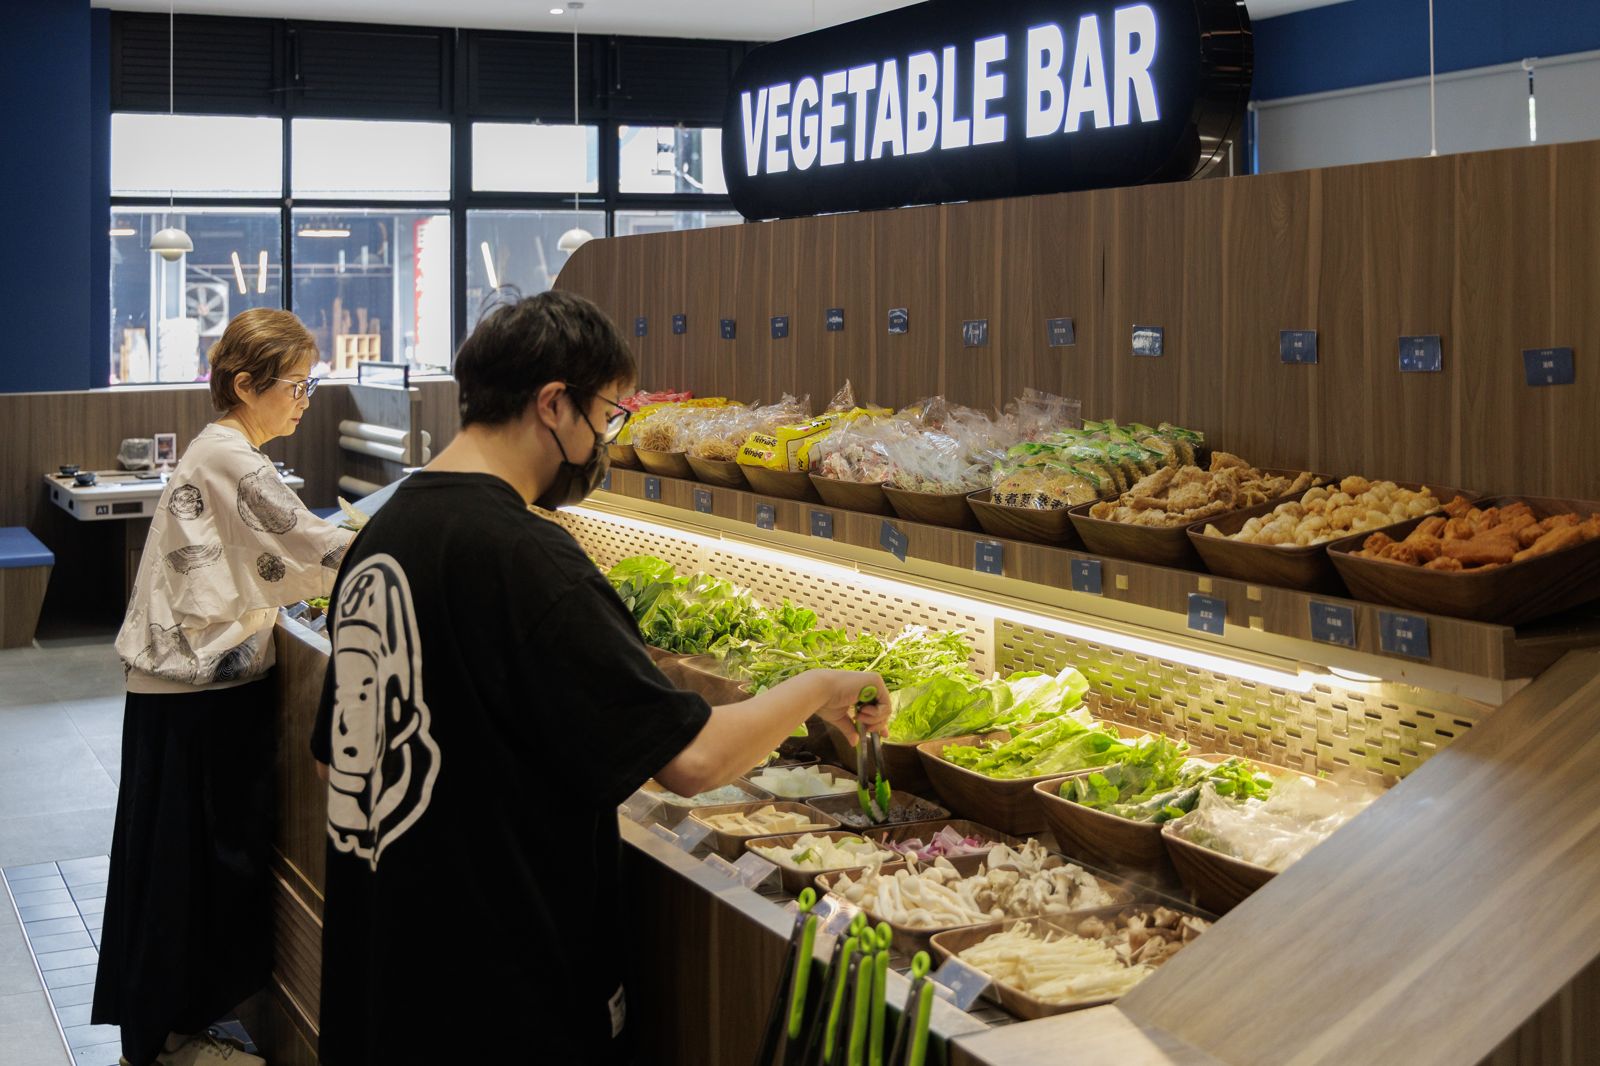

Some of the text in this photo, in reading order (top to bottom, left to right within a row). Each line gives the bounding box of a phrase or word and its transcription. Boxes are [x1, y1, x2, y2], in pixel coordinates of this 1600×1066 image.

[740, 3, 1161, 178] VEGETABLE BAR
[97, 506, 108, 514] A1
